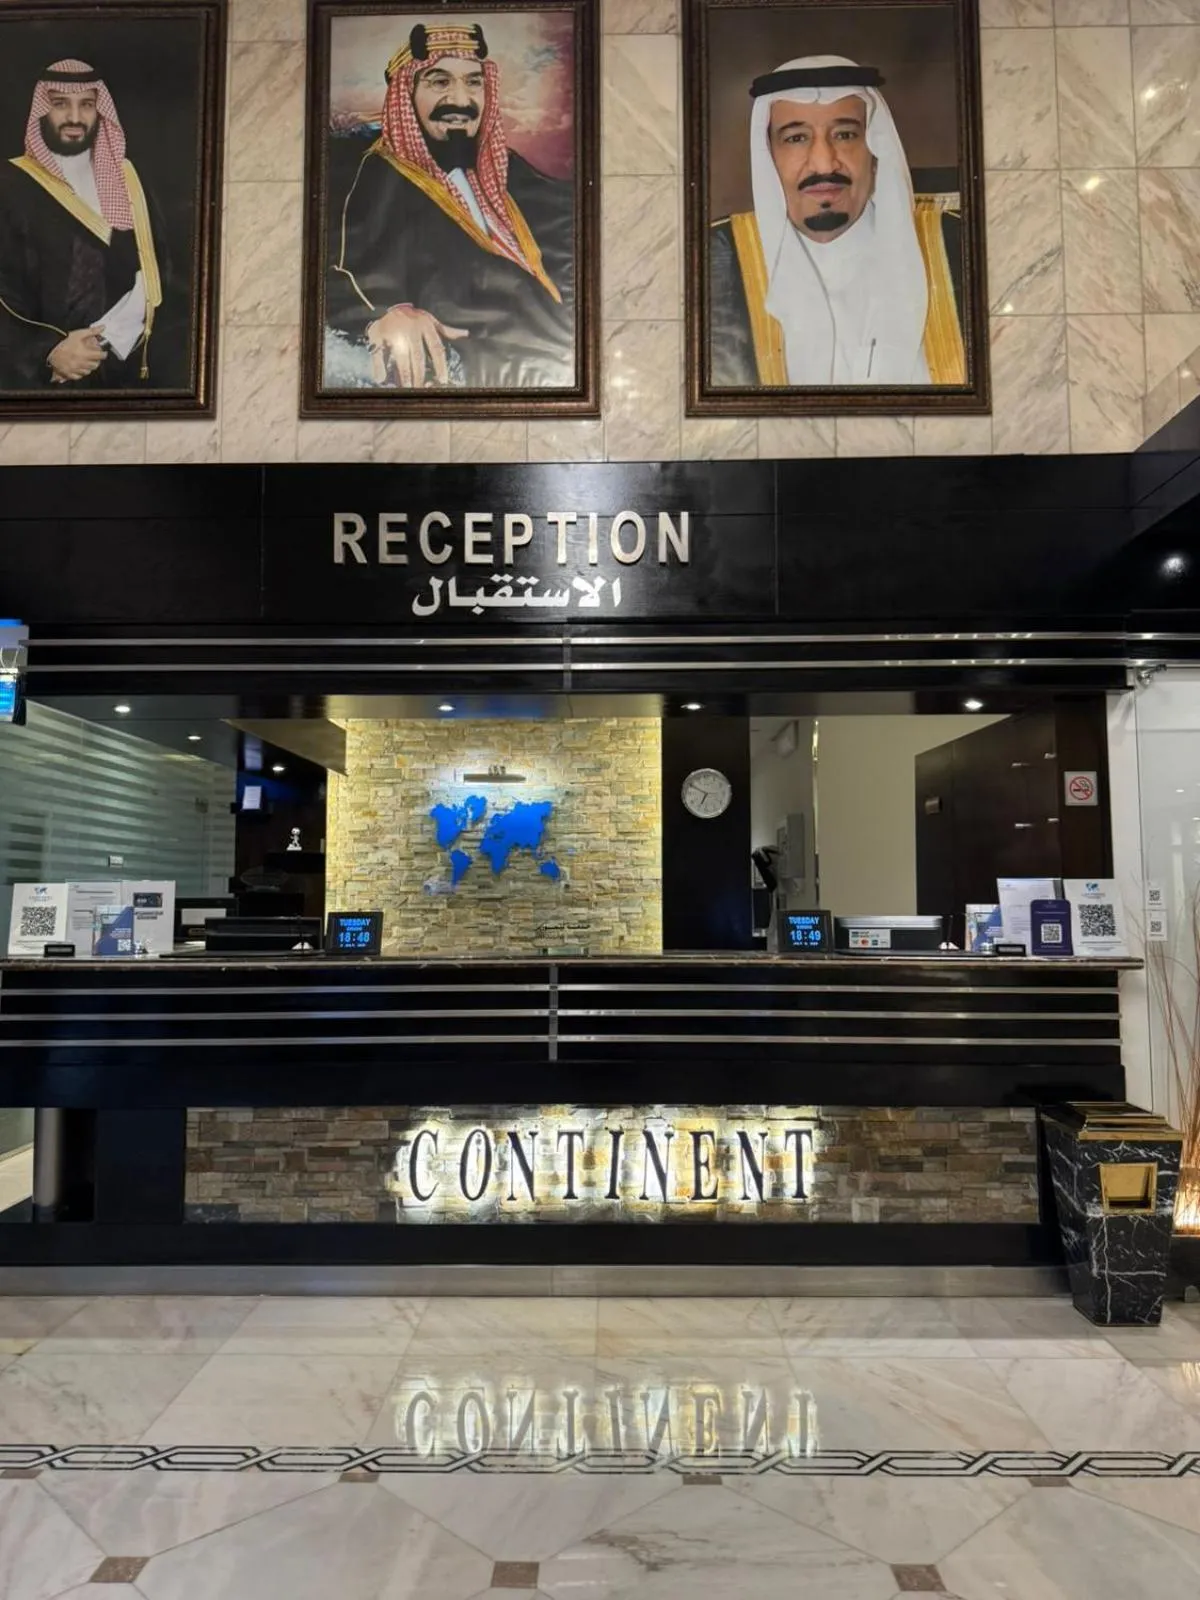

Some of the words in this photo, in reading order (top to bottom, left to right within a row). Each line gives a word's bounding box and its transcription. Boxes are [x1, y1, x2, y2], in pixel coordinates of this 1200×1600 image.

[333, 511, 690, 565] RECEPTION
[411, 573, 622, 616] الاستقبال
[339, 918, 371, 927] TUESDAY
[788, 915, 820, 925] TUESDAY
[408, 1128, 813, 1203] CONTINENT
